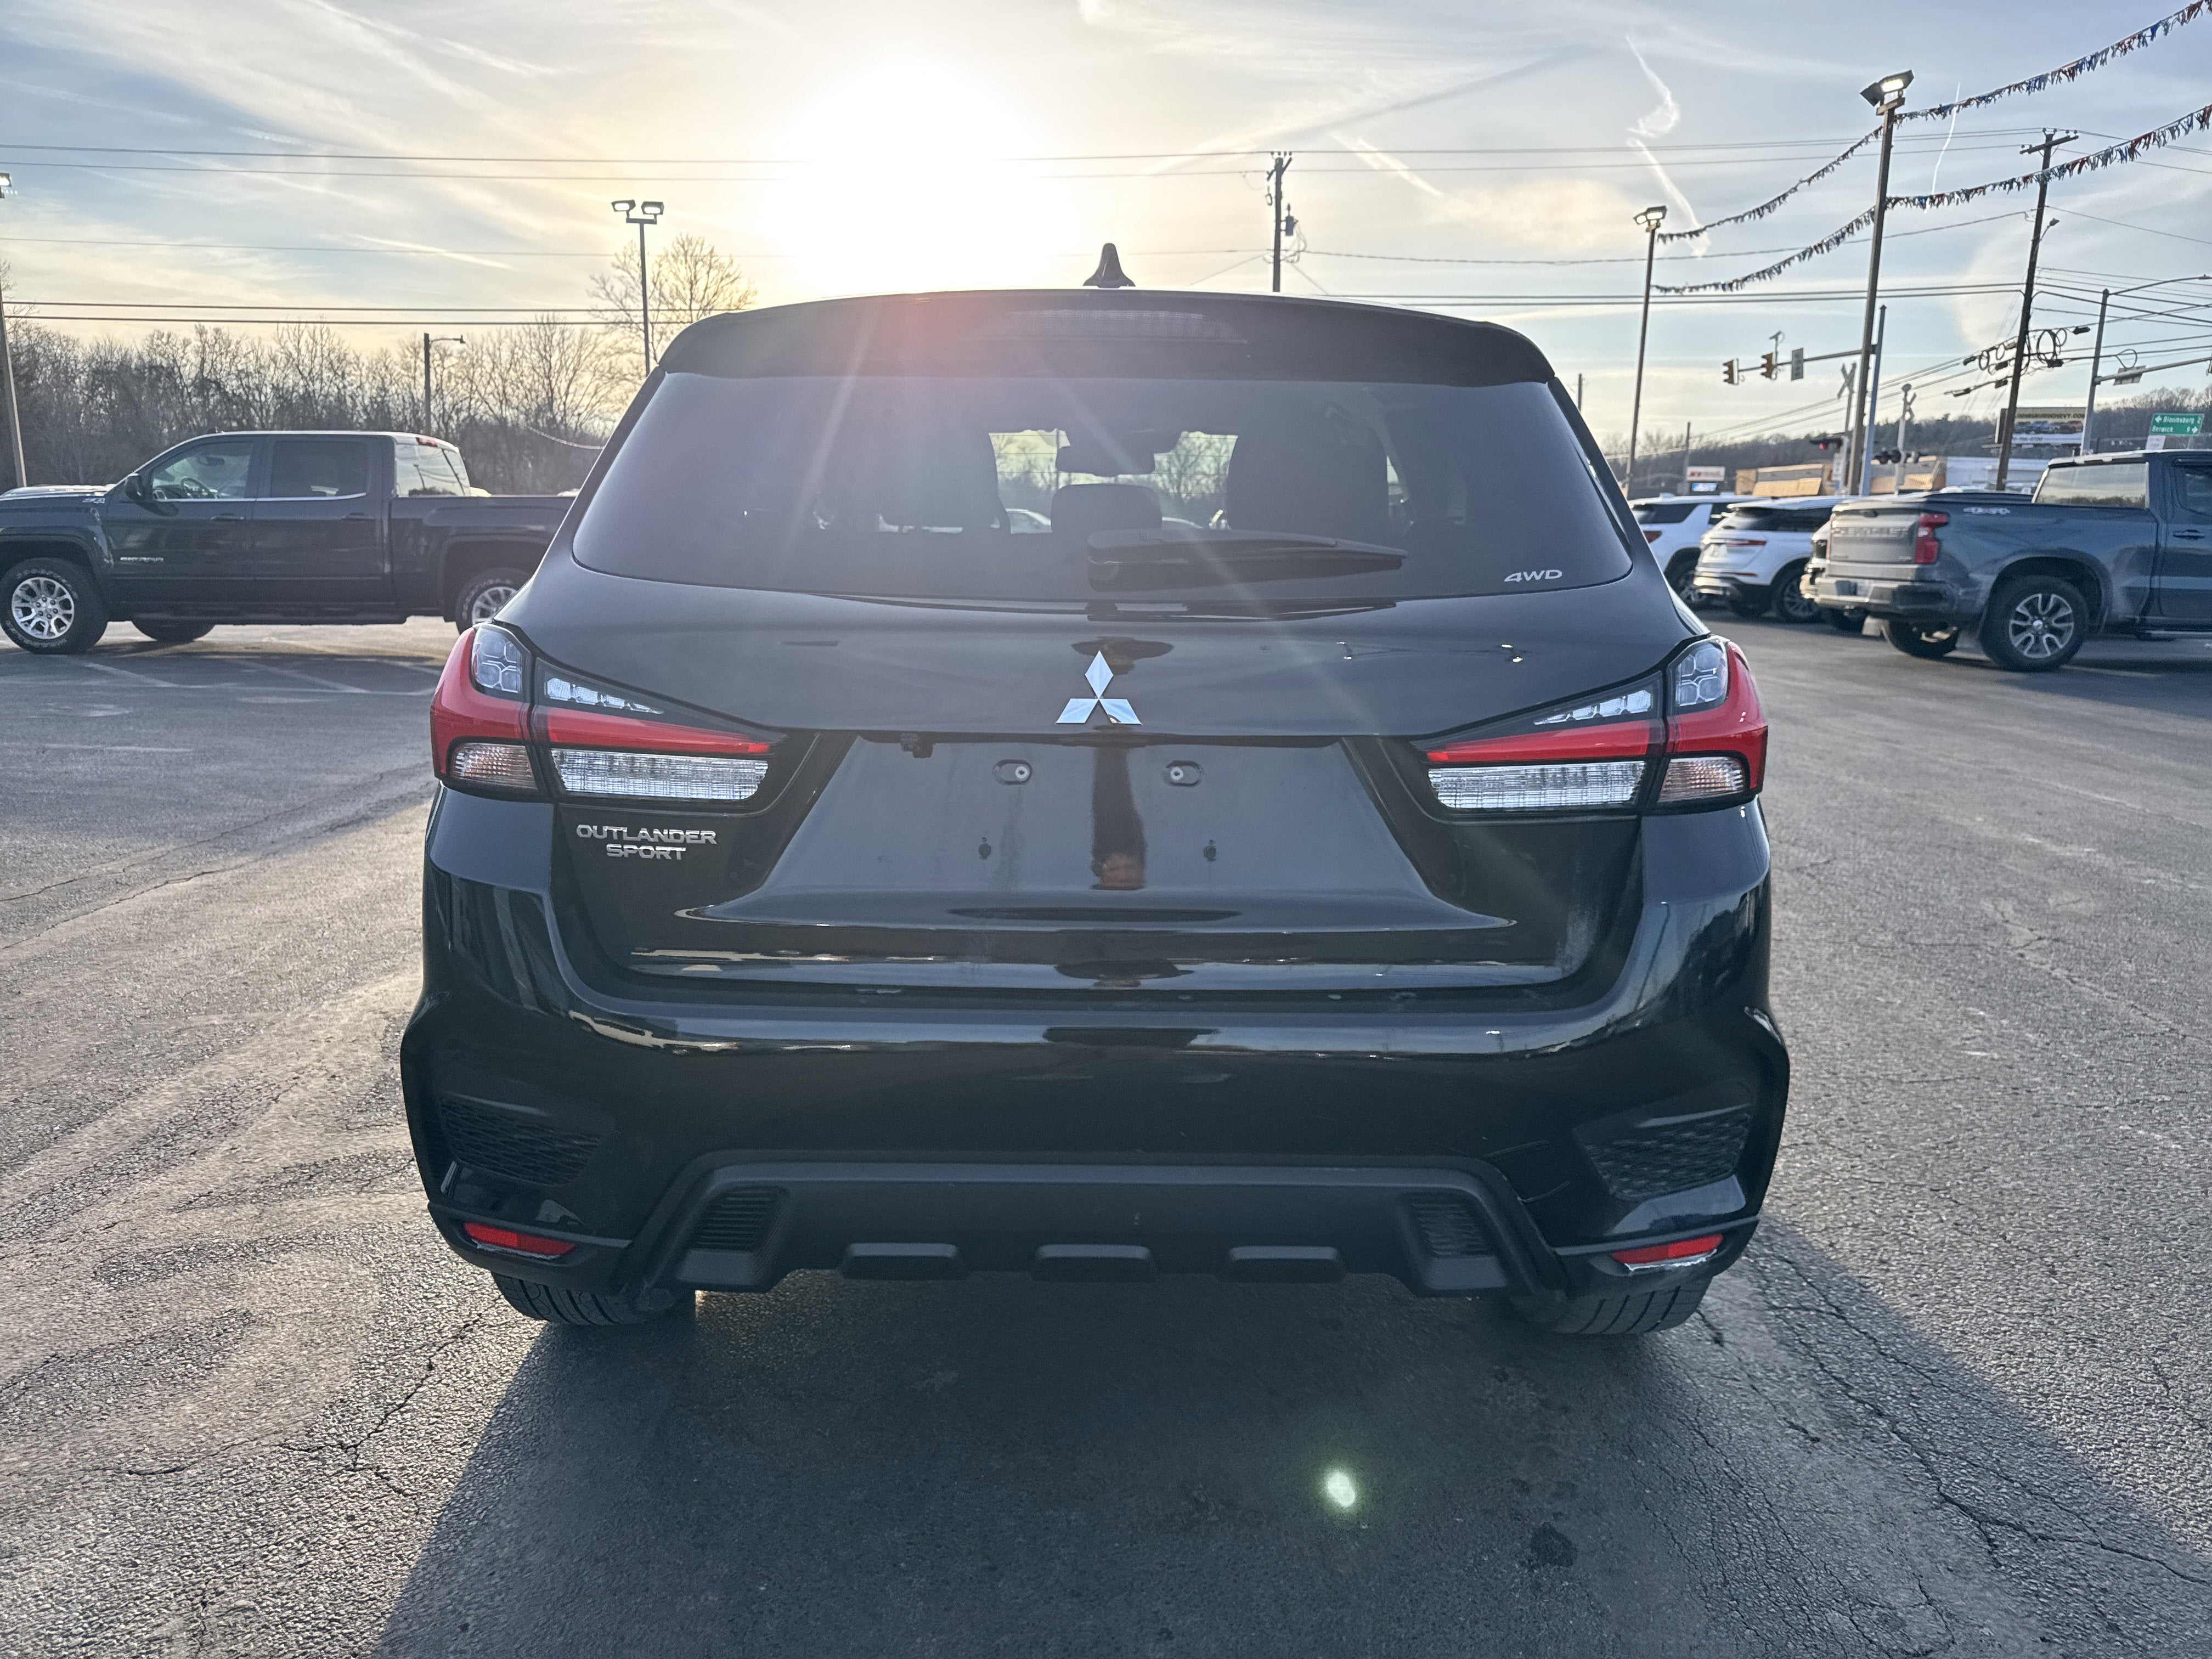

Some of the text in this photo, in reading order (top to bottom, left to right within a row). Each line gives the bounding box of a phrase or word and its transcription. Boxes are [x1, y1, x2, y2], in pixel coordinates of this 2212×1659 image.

[1504, 569, 1562, 582] 4WD
[576, 824, 717, 844] OUTLANDER
[606, 843, 686, 860] SPORT
